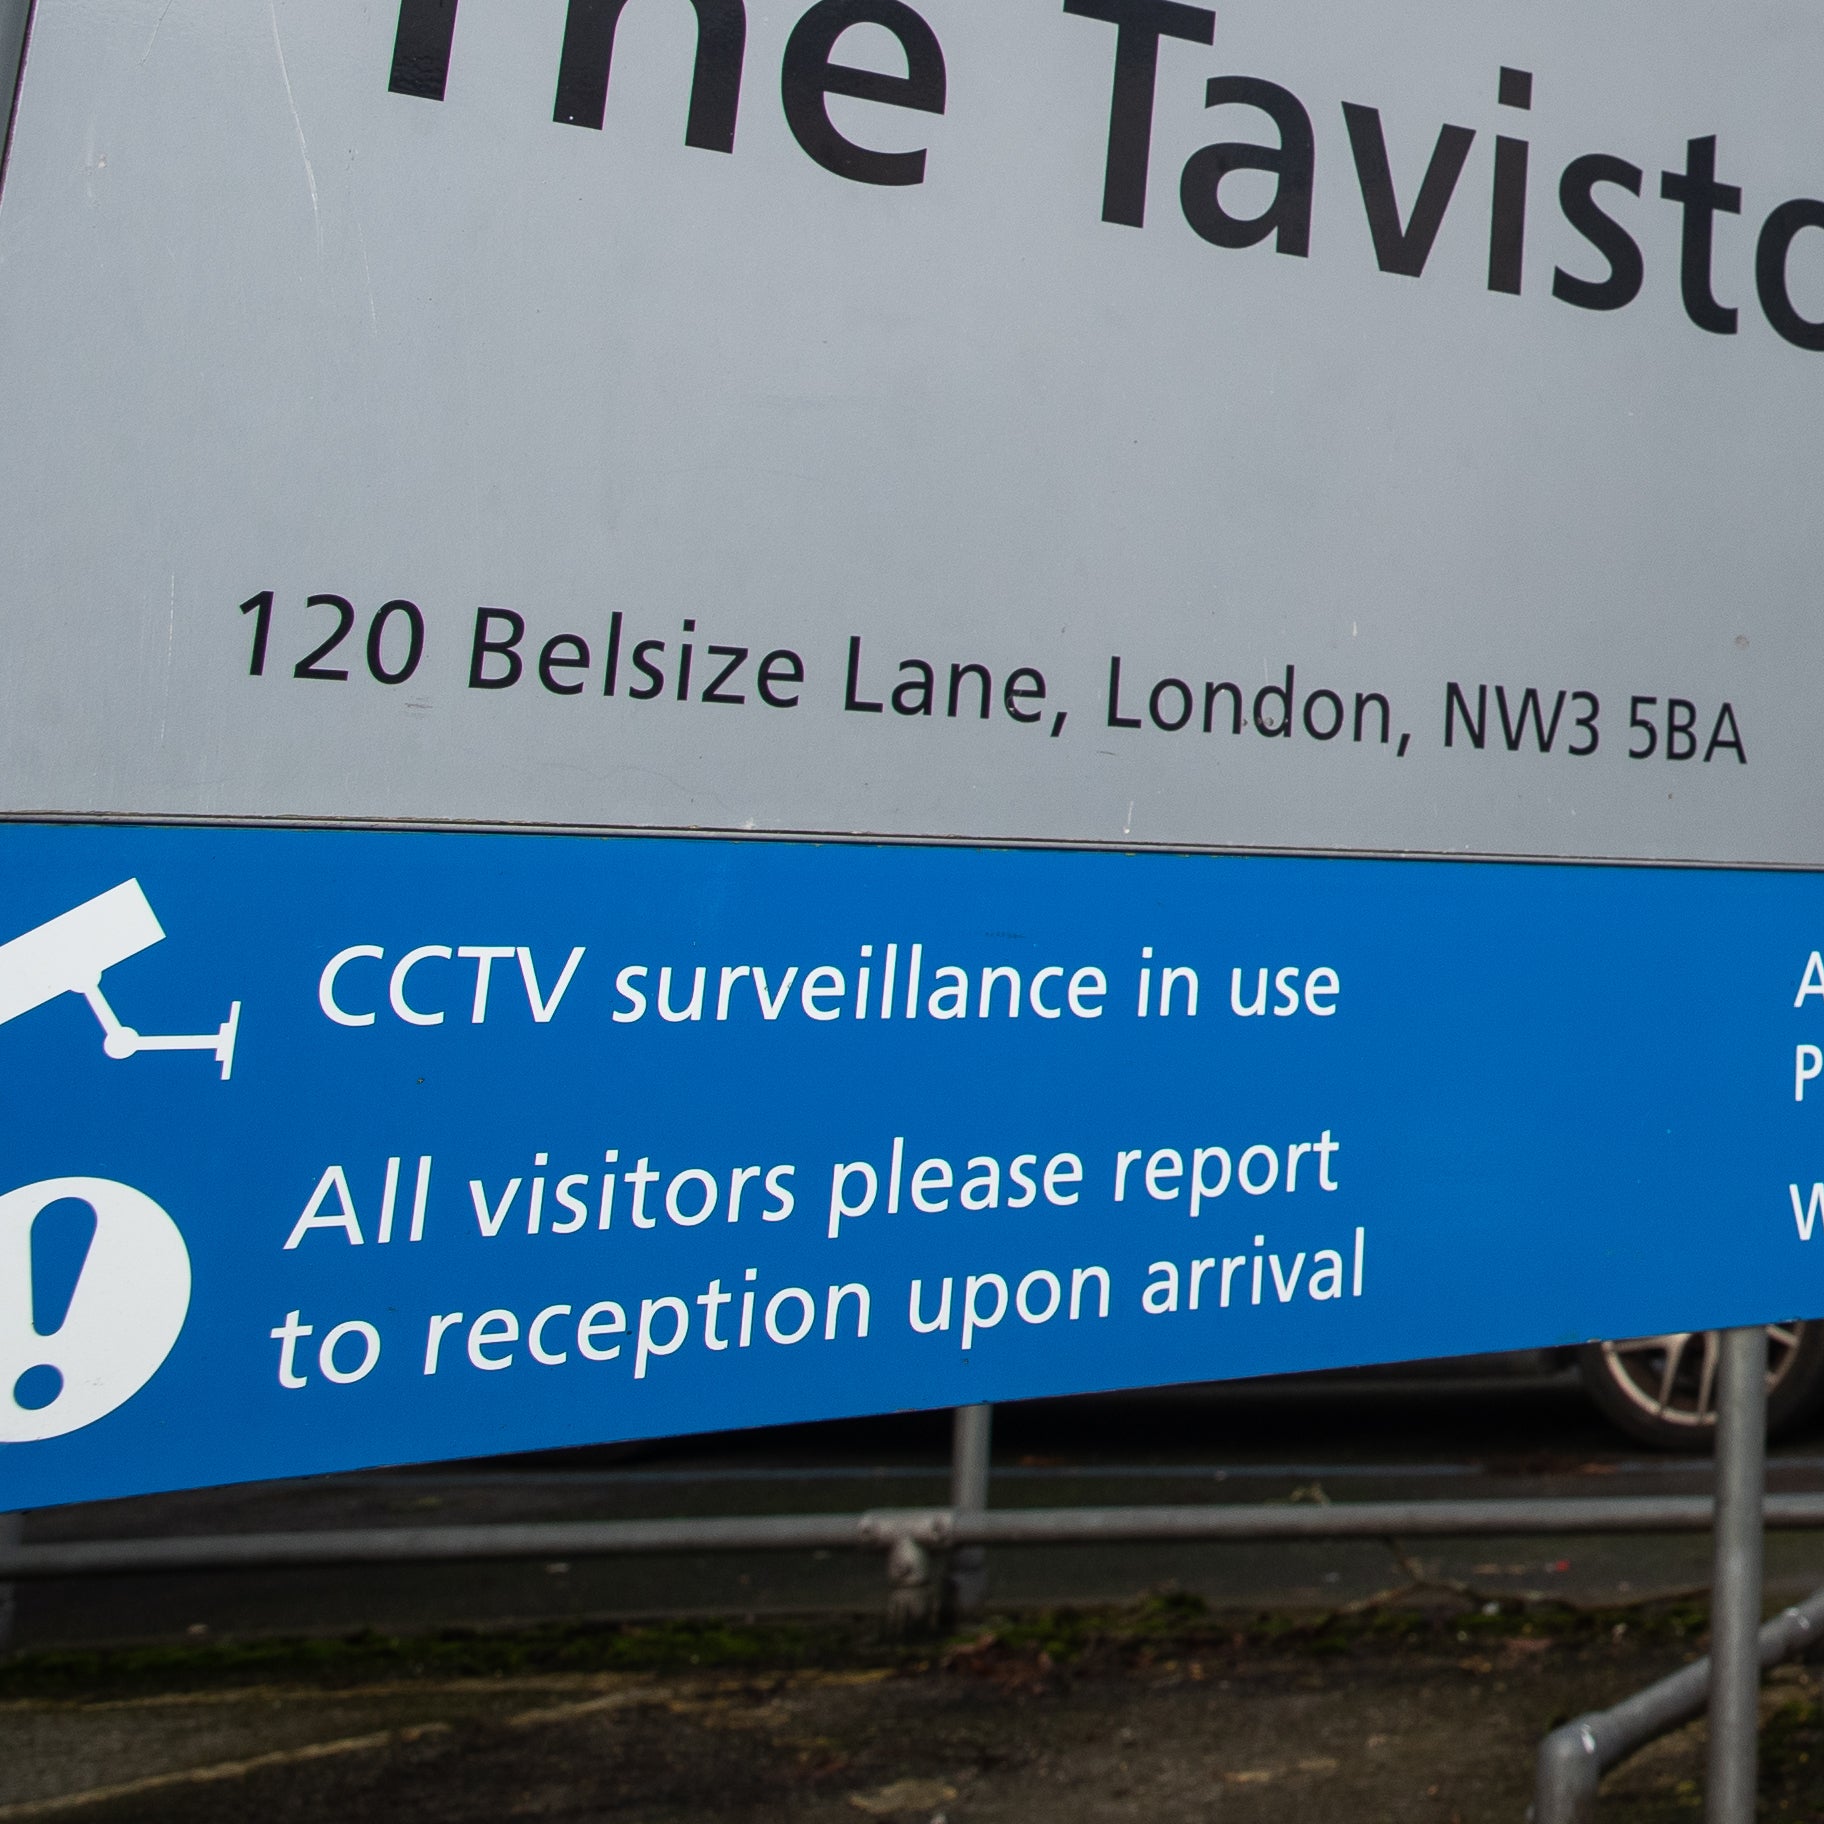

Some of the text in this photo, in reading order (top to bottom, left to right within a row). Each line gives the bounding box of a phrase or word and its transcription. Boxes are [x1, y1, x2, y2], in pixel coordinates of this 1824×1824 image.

[241, 590, 1748, 765] 120 Belsize Lane, London, NW3 5BA
[318, 943, 1340, 1027] CCTV surveillance in use
[282, 1129, 1340, 1250] All visitors please report
[269, 1226, 1365, 1389] to reception upon arrival
